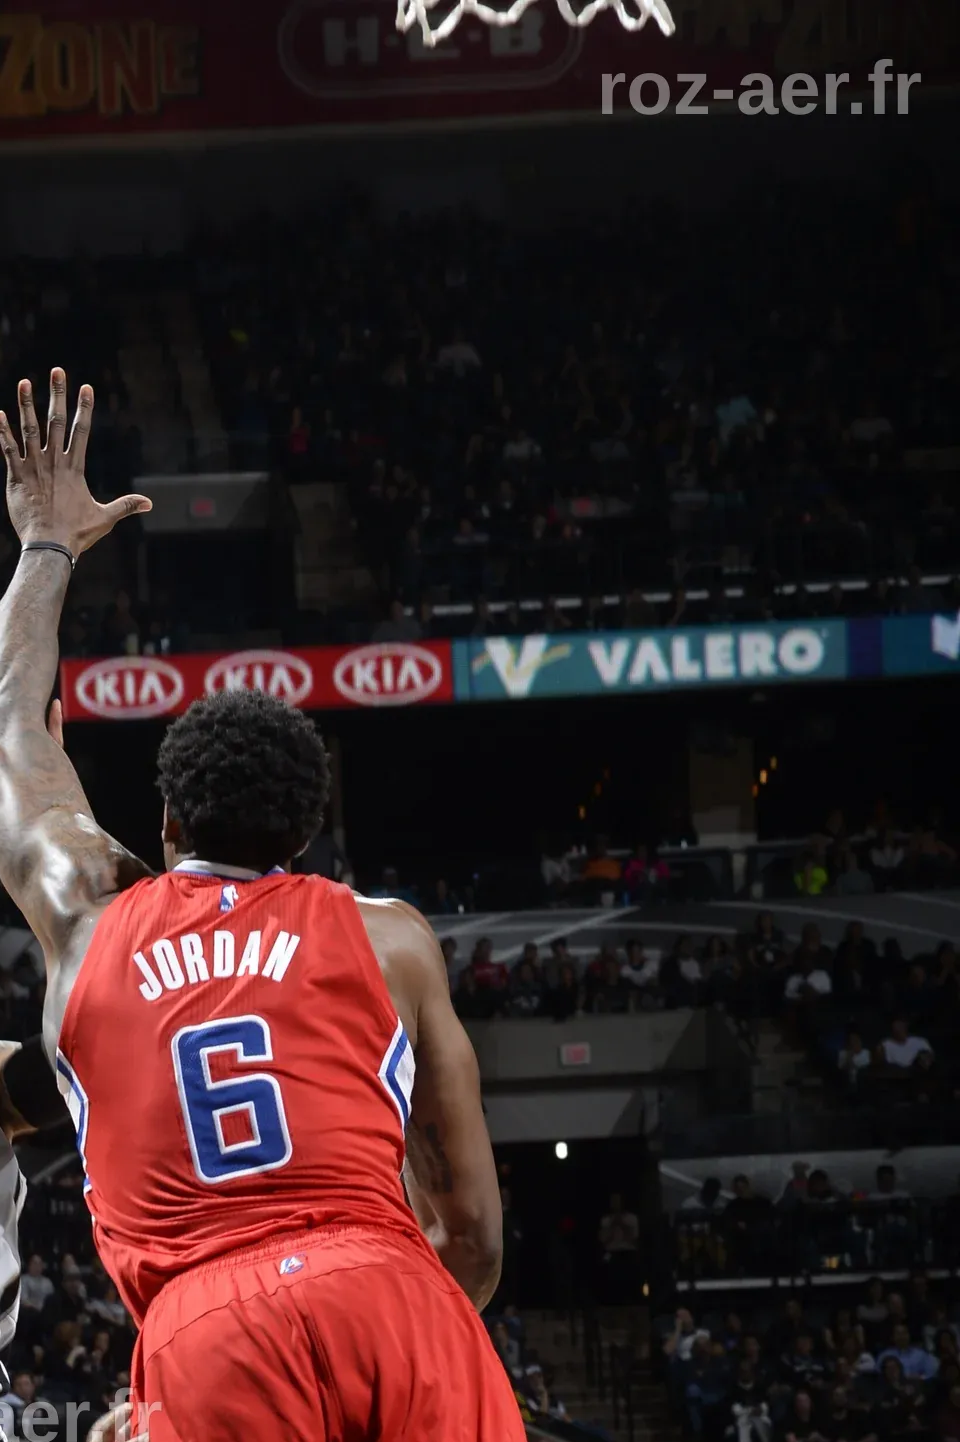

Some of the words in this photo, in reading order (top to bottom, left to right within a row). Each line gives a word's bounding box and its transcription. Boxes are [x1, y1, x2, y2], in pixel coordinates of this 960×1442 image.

[353, 658, 423, 699] KIA
[588, 628, 825, 687] VALERO
[95, 671, 165, 706] KIA
[133, 930, 300, 1001] JORDAN
[171, 1014, 292, 1184] 6
